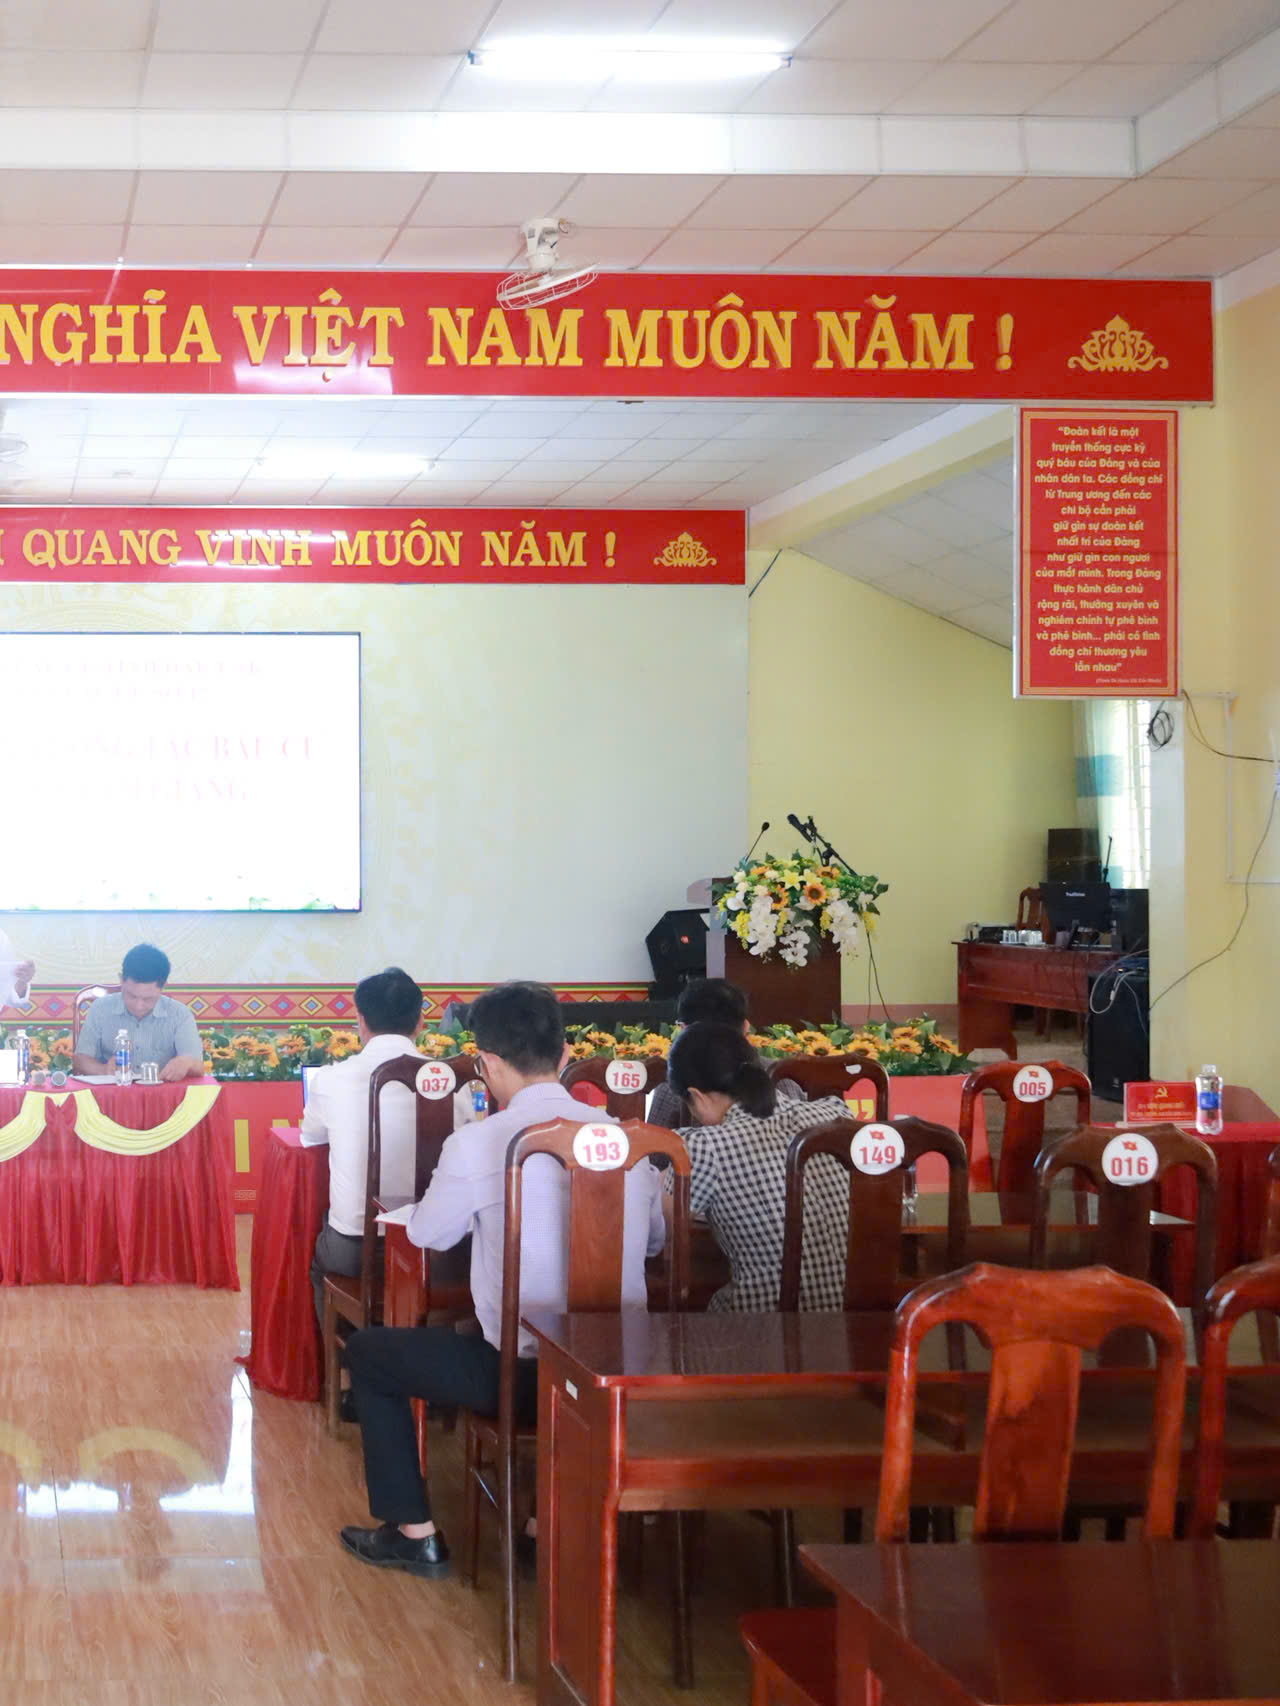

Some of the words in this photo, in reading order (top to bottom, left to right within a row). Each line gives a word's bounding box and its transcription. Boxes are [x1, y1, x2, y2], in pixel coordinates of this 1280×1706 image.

[232, 288, 404, 382] VIỆT
[427, 308, 584, 366] NAM
[605, 293, 793, 369] MUÔN
[814, 295, 974, 370] NĂM
[996, 314, 1015, 371] !
[23, 529, 182, 570] QUANG
[195, 529, 313, 567] VINH
[331, 519, 462, 567] MUÔN
[482, 521, 587, 567] NĂM
[422, 1076, 449, 1092] 037
[615, 1072, 640, 1088] 165
[1019, 1082, 1046, 1096] 005
[582, 1143, 620, 1164] 193
[860, 1145, 897, 1165] 149
[1112, 1156, 1149, 1176] 016
